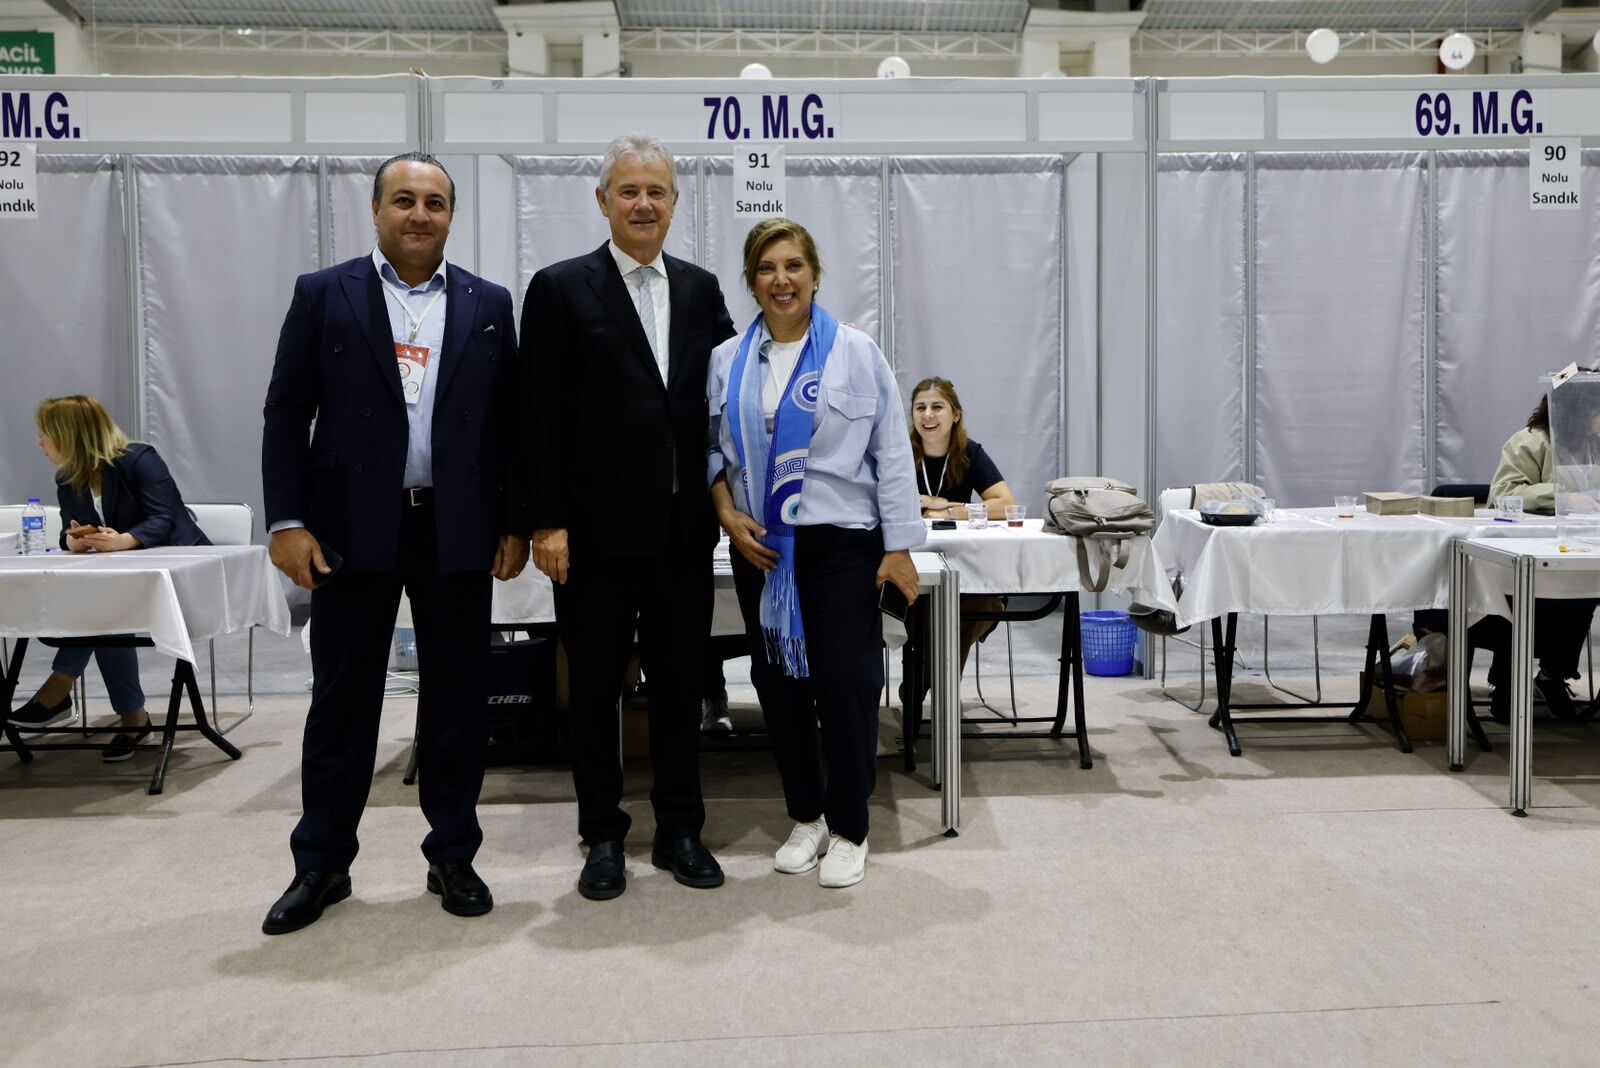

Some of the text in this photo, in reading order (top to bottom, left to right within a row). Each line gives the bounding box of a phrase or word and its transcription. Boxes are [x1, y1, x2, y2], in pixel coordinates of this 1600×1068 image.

[2, 92, 80, 139] M.G.
[703, 93, 833, 140] 70. M.G.
[1416, 89, 1543, 136] 69. M.G.
[0, 151, 21, 167] 92
[1544, 145, 1566, 160] 90
[748, 153, 770, 168] 91
[1542, 173, 1568, 183] Nolu
[746, 181, 773, 191] Nolu
[1532, 192, 1578, 204] Sandık
[736, 200, 783, 212] Sandık
